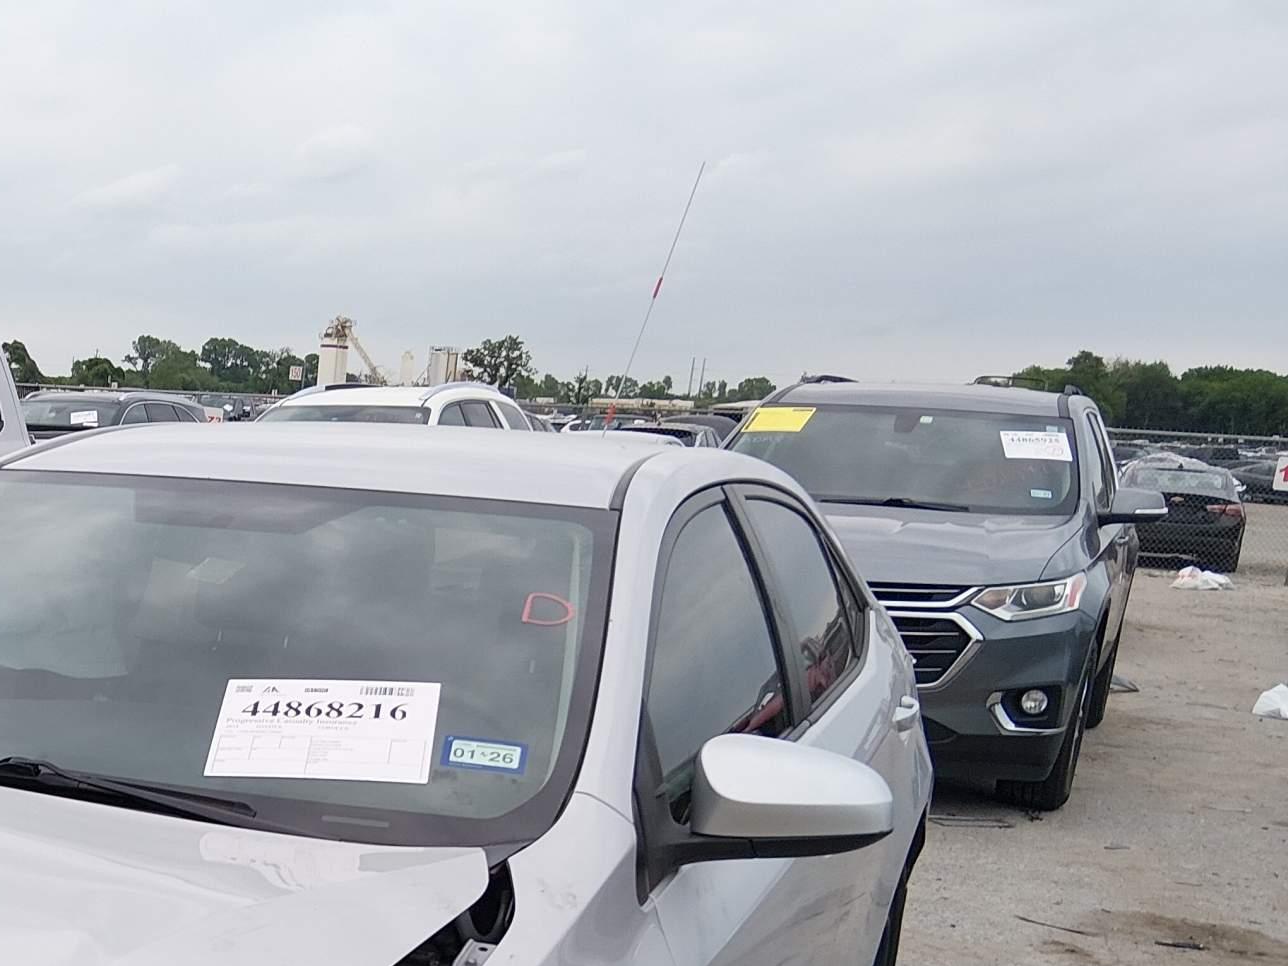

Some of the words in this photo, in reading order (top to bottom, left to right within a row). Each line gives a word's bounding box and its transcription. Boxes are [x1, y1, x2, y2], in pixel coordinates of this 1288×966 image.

[241, 700, 408, 721] 44868216
[453, 748, 475, 760] 01
[488, 752, 514, 764] 26
